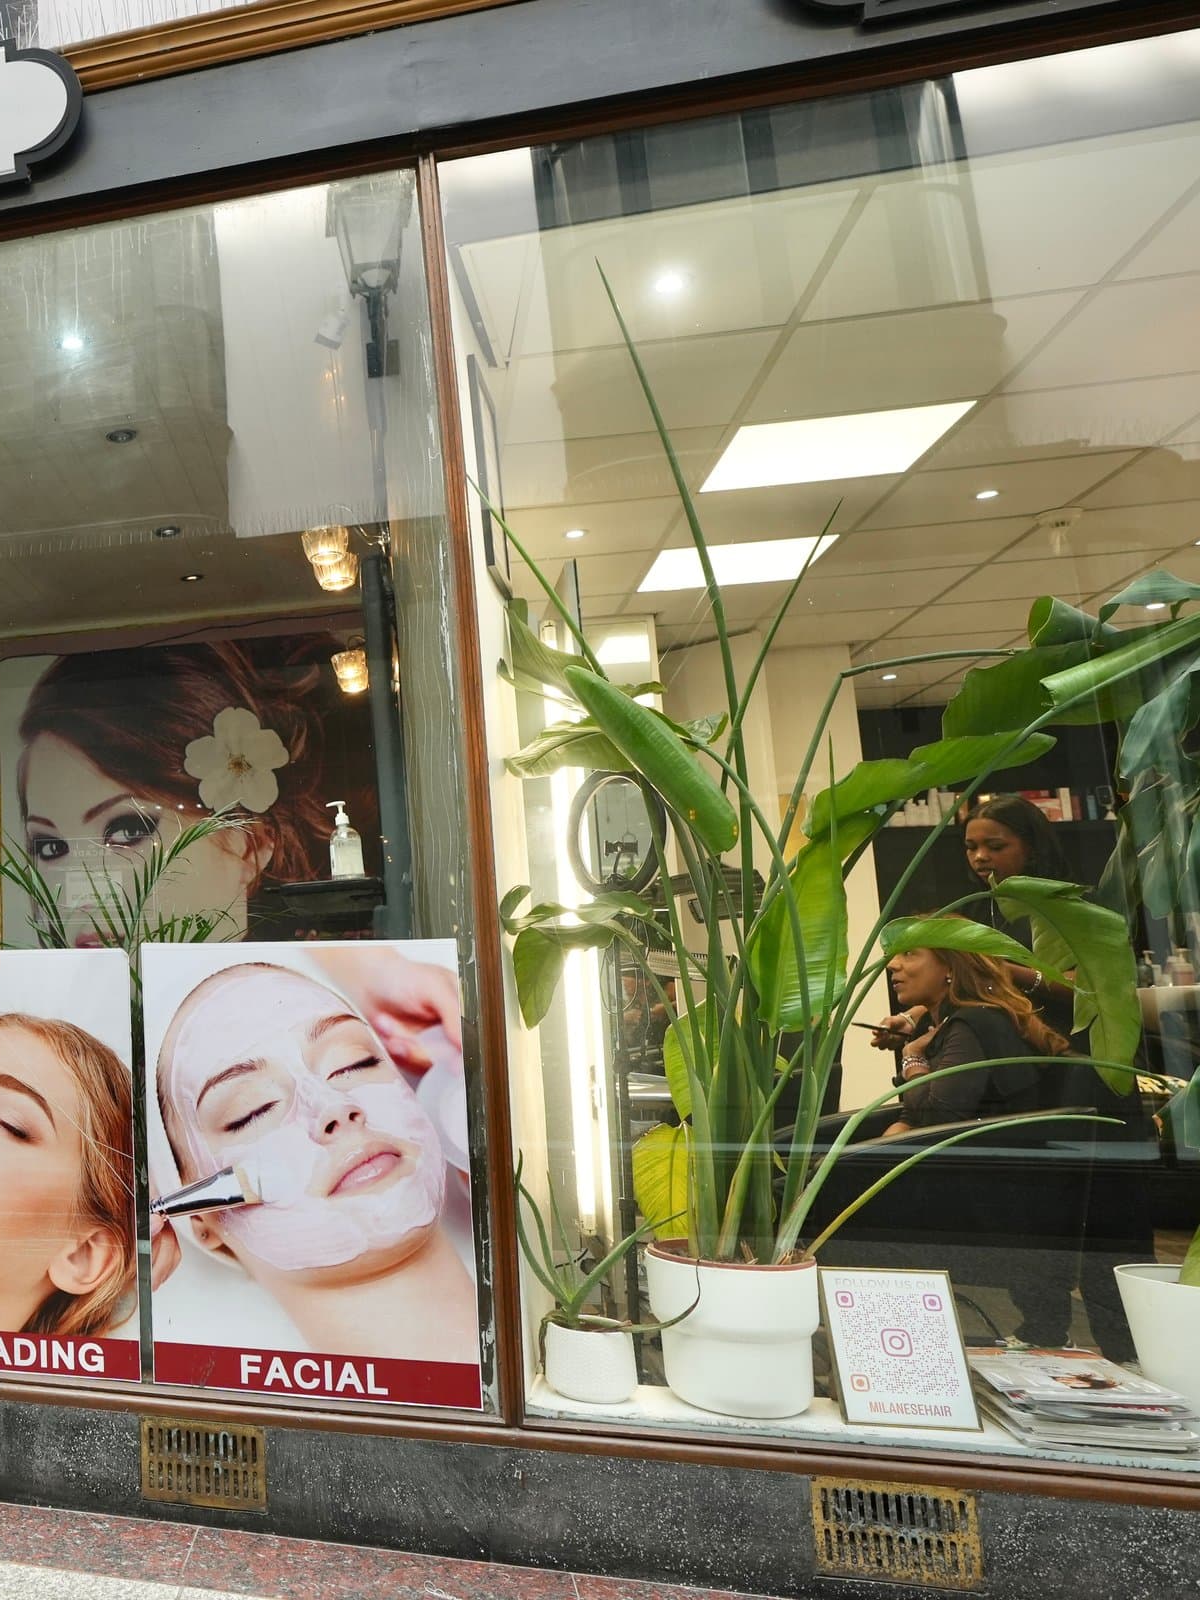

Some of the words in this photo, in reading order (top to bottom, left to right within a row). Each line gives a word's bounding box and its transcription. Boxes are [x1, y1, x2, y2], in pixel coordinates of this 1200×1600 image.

[834, 1278, 890, 1289] FOLLOW
[894, 1279, 912, 1289] US
[915, 1280, 936, 1290] ON
[239, 1354, 389, 1396] FACIAL
[869, 1401, 952, 1417] MILANESEHAIR
